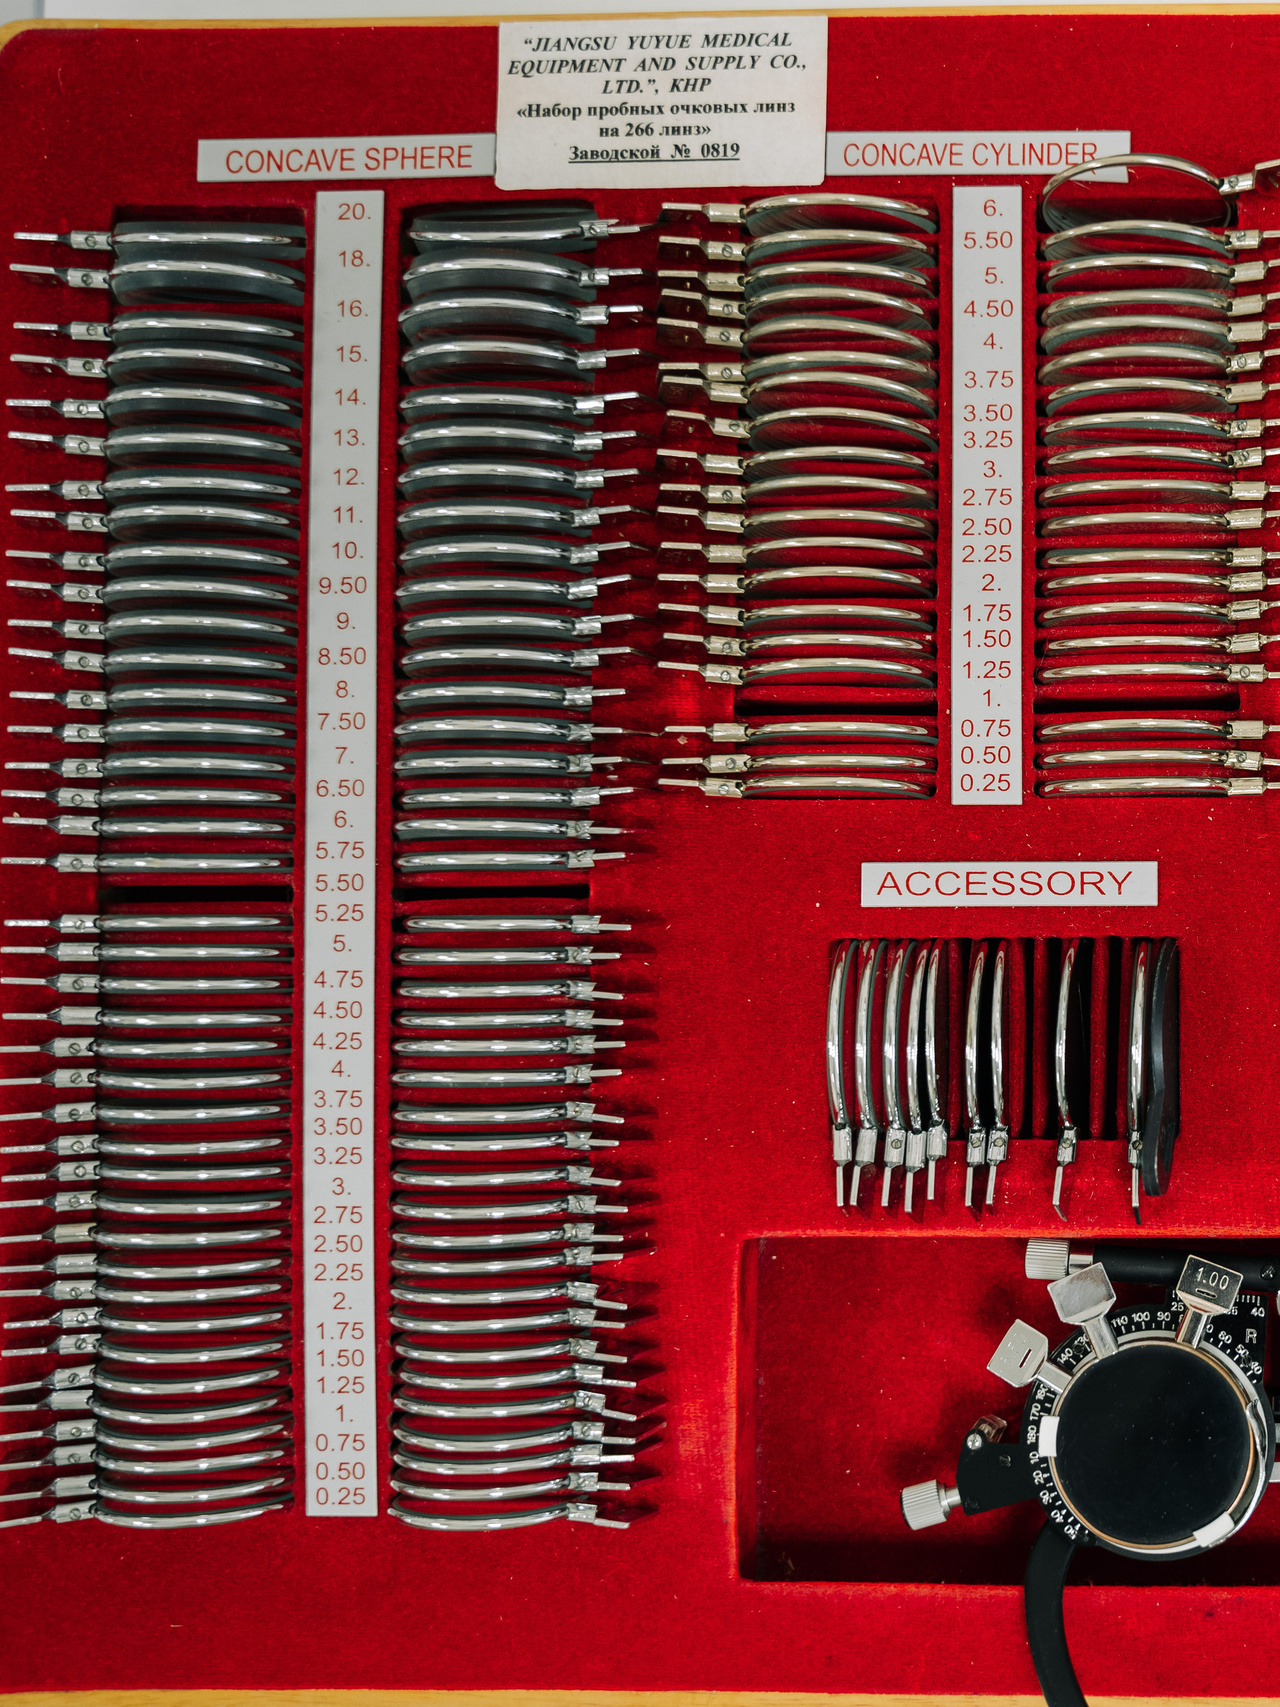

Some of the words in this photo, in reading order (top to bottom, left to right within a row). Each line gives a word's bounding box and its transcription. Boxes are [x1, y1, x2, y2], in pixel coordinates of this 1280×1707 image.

[627, 34, 692, 51] YUYUE
[700, 32, 792, 49] MEDICAL
[507, 57, 627, 78] EQUIPMENT
[634, 56, 677, 73] AND
[685, 55, 761, 72] SUPPLY
[769, 54, 807, 71] CO.,
[517, 103, 582, 121] «Набор
[587, 101, 665, 119] пробных
[670, 102, 748, 116] очковых
[753, 101, 796, 115] линз
[599, 126, 619, 139] на
[625, 123, 655, 138] 266
[659, 124, 711, 137] линз»
[225, 148, 356, 174] CONCAVE
[364, 145, 473, 171] SPHERE
[569, 145, 661, 161] Заводской
[671, 144, 691, 159] №
[700, 143, 740, 158] 0819
[843, 142, 964, 167] CONCAVE
[972, 142, 1098, 168] CYLINDER
[963, 230, 1014, 250] 5.50
[963, 299, 1014, 318] 4.50
[963, 369, 1014, 390] 3.75
[962, 403, 1014, 423] 3.50
[962, 429, 1014, 450] 3.25
[962, 487, 1013, 507] 2.75
[961, 517, 1013, 537] 2.50
[961, 544, 1013, 564] 2.25
[318, 575, 368, 595] 9.50
[962, 603, 1012, 623] 1.75
[962, 628, 1012, 649] 1.50
[317, 646, 367, 666] 8.50
[962, 660, 1012, 680] 1.25
[317, 711, 366, 731] 7.50
[960, 718, 1012, 738] 0.75
[960, 745, 1012, 765] 0.50
[315, 778, 365, 798] 6.50
[959, 772, 1011, 793] 0.25
[315, 840, 365, 860] 5.75
[315, 872, 365, 893] 5.50
[876, 870, 1133, 896] ACCESSORY
[314, 903, 365, 923] 5.25
[313, 969, 364, 989] 4.75
[312, 1000, 363, 1020] 4.50
[312, 1031, 363, 1051] 4.25
[313, 1089, 363, 1109] 3.75
[313, 1116, 363, 1136] 3.50
[313, 1146, 363, 1166] 3.25
[313, 1205, 363, 1225] 2.75
[313, 1234, 364, 1254] 2.50
[313, 1262, 364, 1282] 2.25
[1196, 1267, 1230, 1291] 1.00
[1131, 1311, 1151, 1323] 100
[1157, 1311, 1171, 1322] 90
[1250, 1307, 1265, 1318] 40
[316, 1321, 365, 1341] 1.75
[1245, 1328, 1257, 1344] R
[316, 1348, 365, 1368] 1.50
[316, 1375, 366, 1395] 1.25
[315, 1433, 366, 1453] 0.75
[315, 1461, 366, 1481] 0.50
[315, 1486, 366, 1506] 0.25
